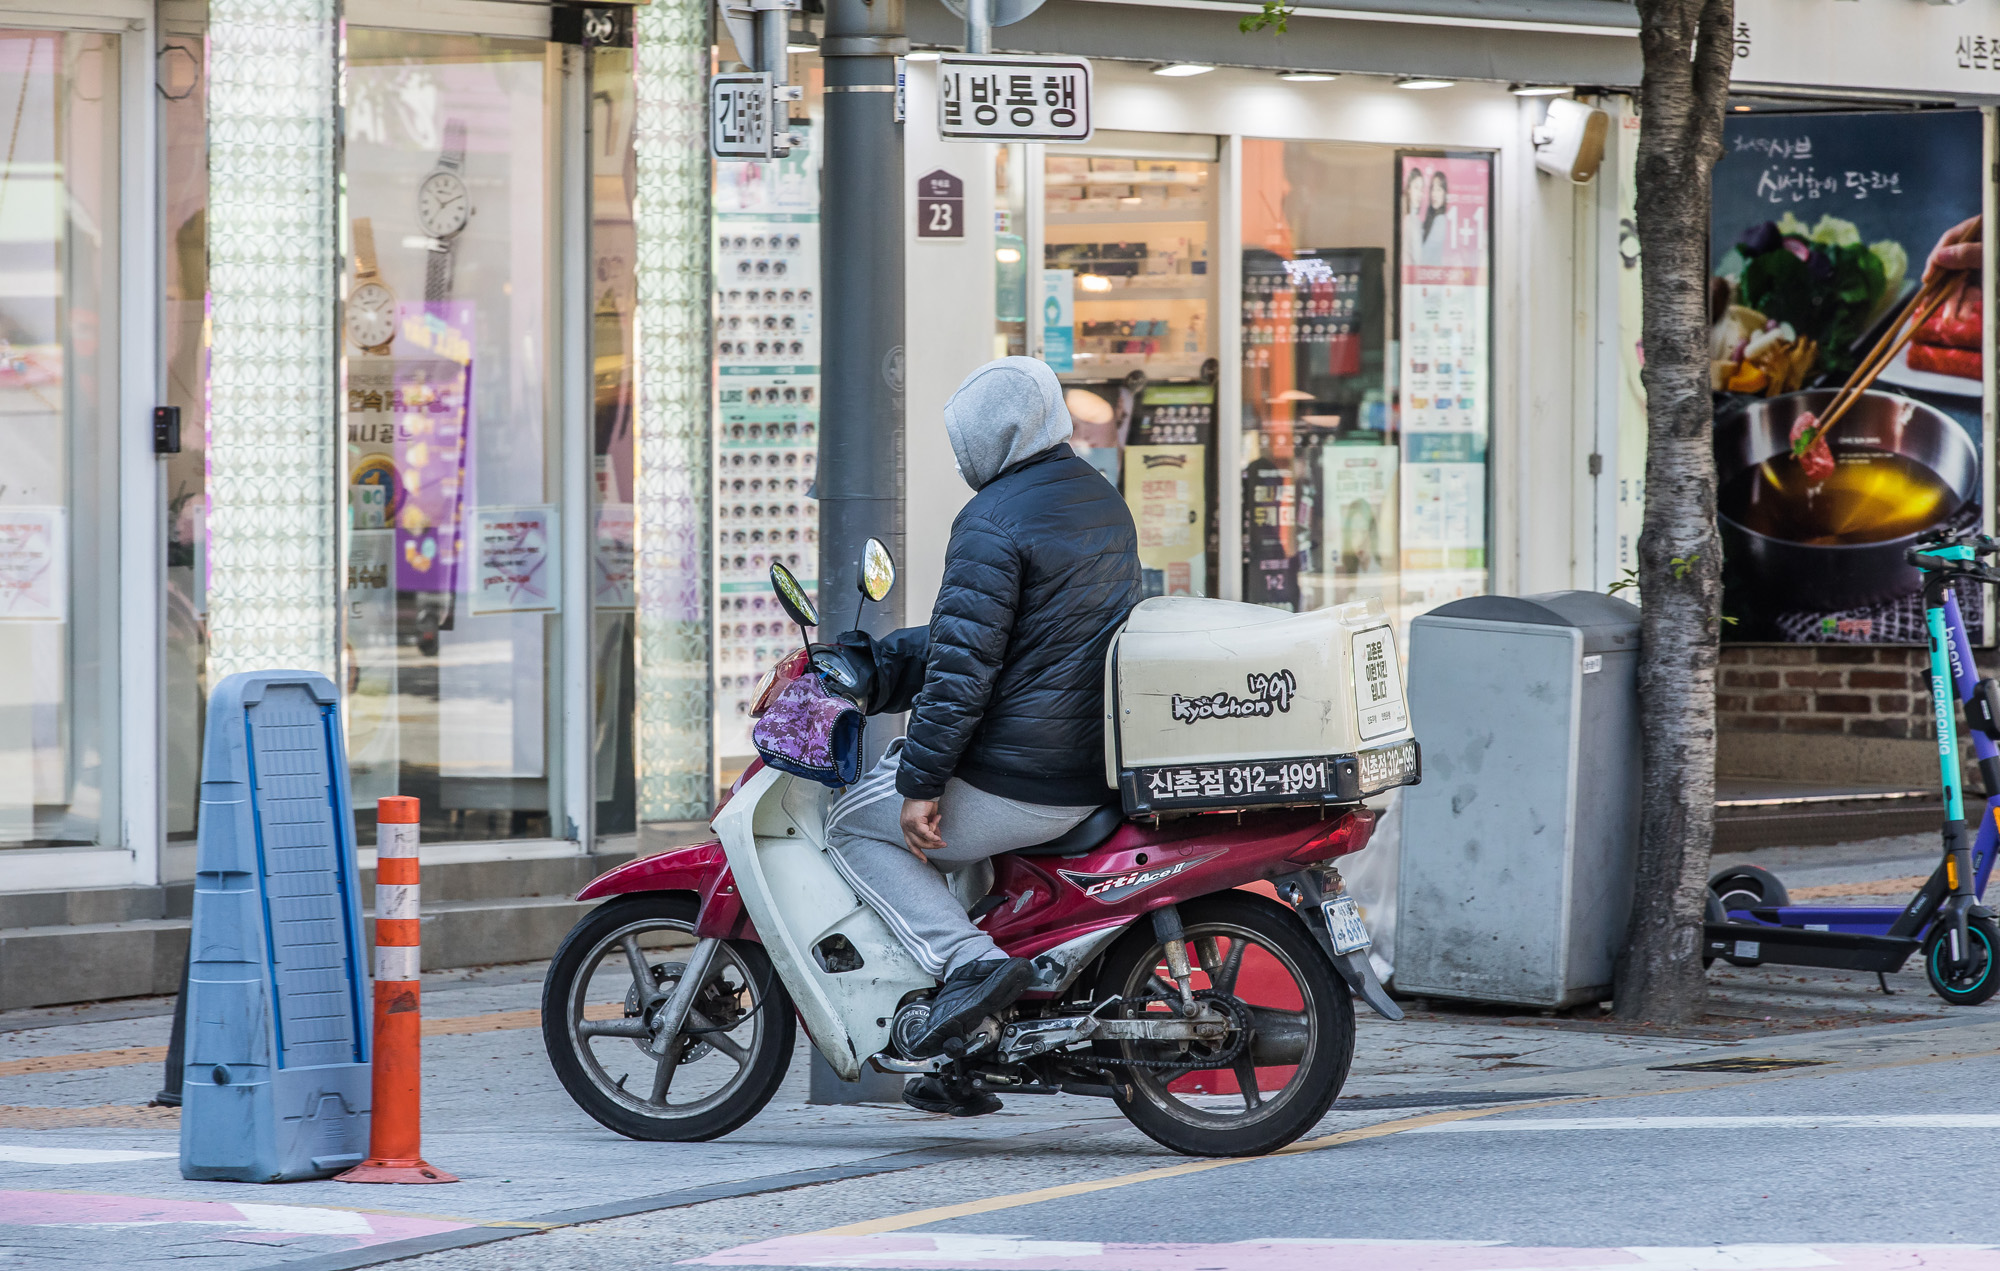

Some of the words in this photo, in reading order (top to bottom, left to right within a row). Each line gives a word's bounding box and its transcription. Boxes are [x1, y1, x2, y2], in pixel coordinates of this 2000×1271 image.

[944, 73, 1076, 128] 일방통행
[929, 204, 953, 231] 23
[1447, 205, 1485, 249] 1+1
[1946, 627, 1965, 678] beam
[1931, 675, 1951, 756] KICKGOING
[1149, 768, 1225, 799] 신촌점
[1229, 762, 1326, 794] 312-1991
[1361, 751, 1387, 783] 신촌점
[1387, 744, 1417, 777] 312-1991
